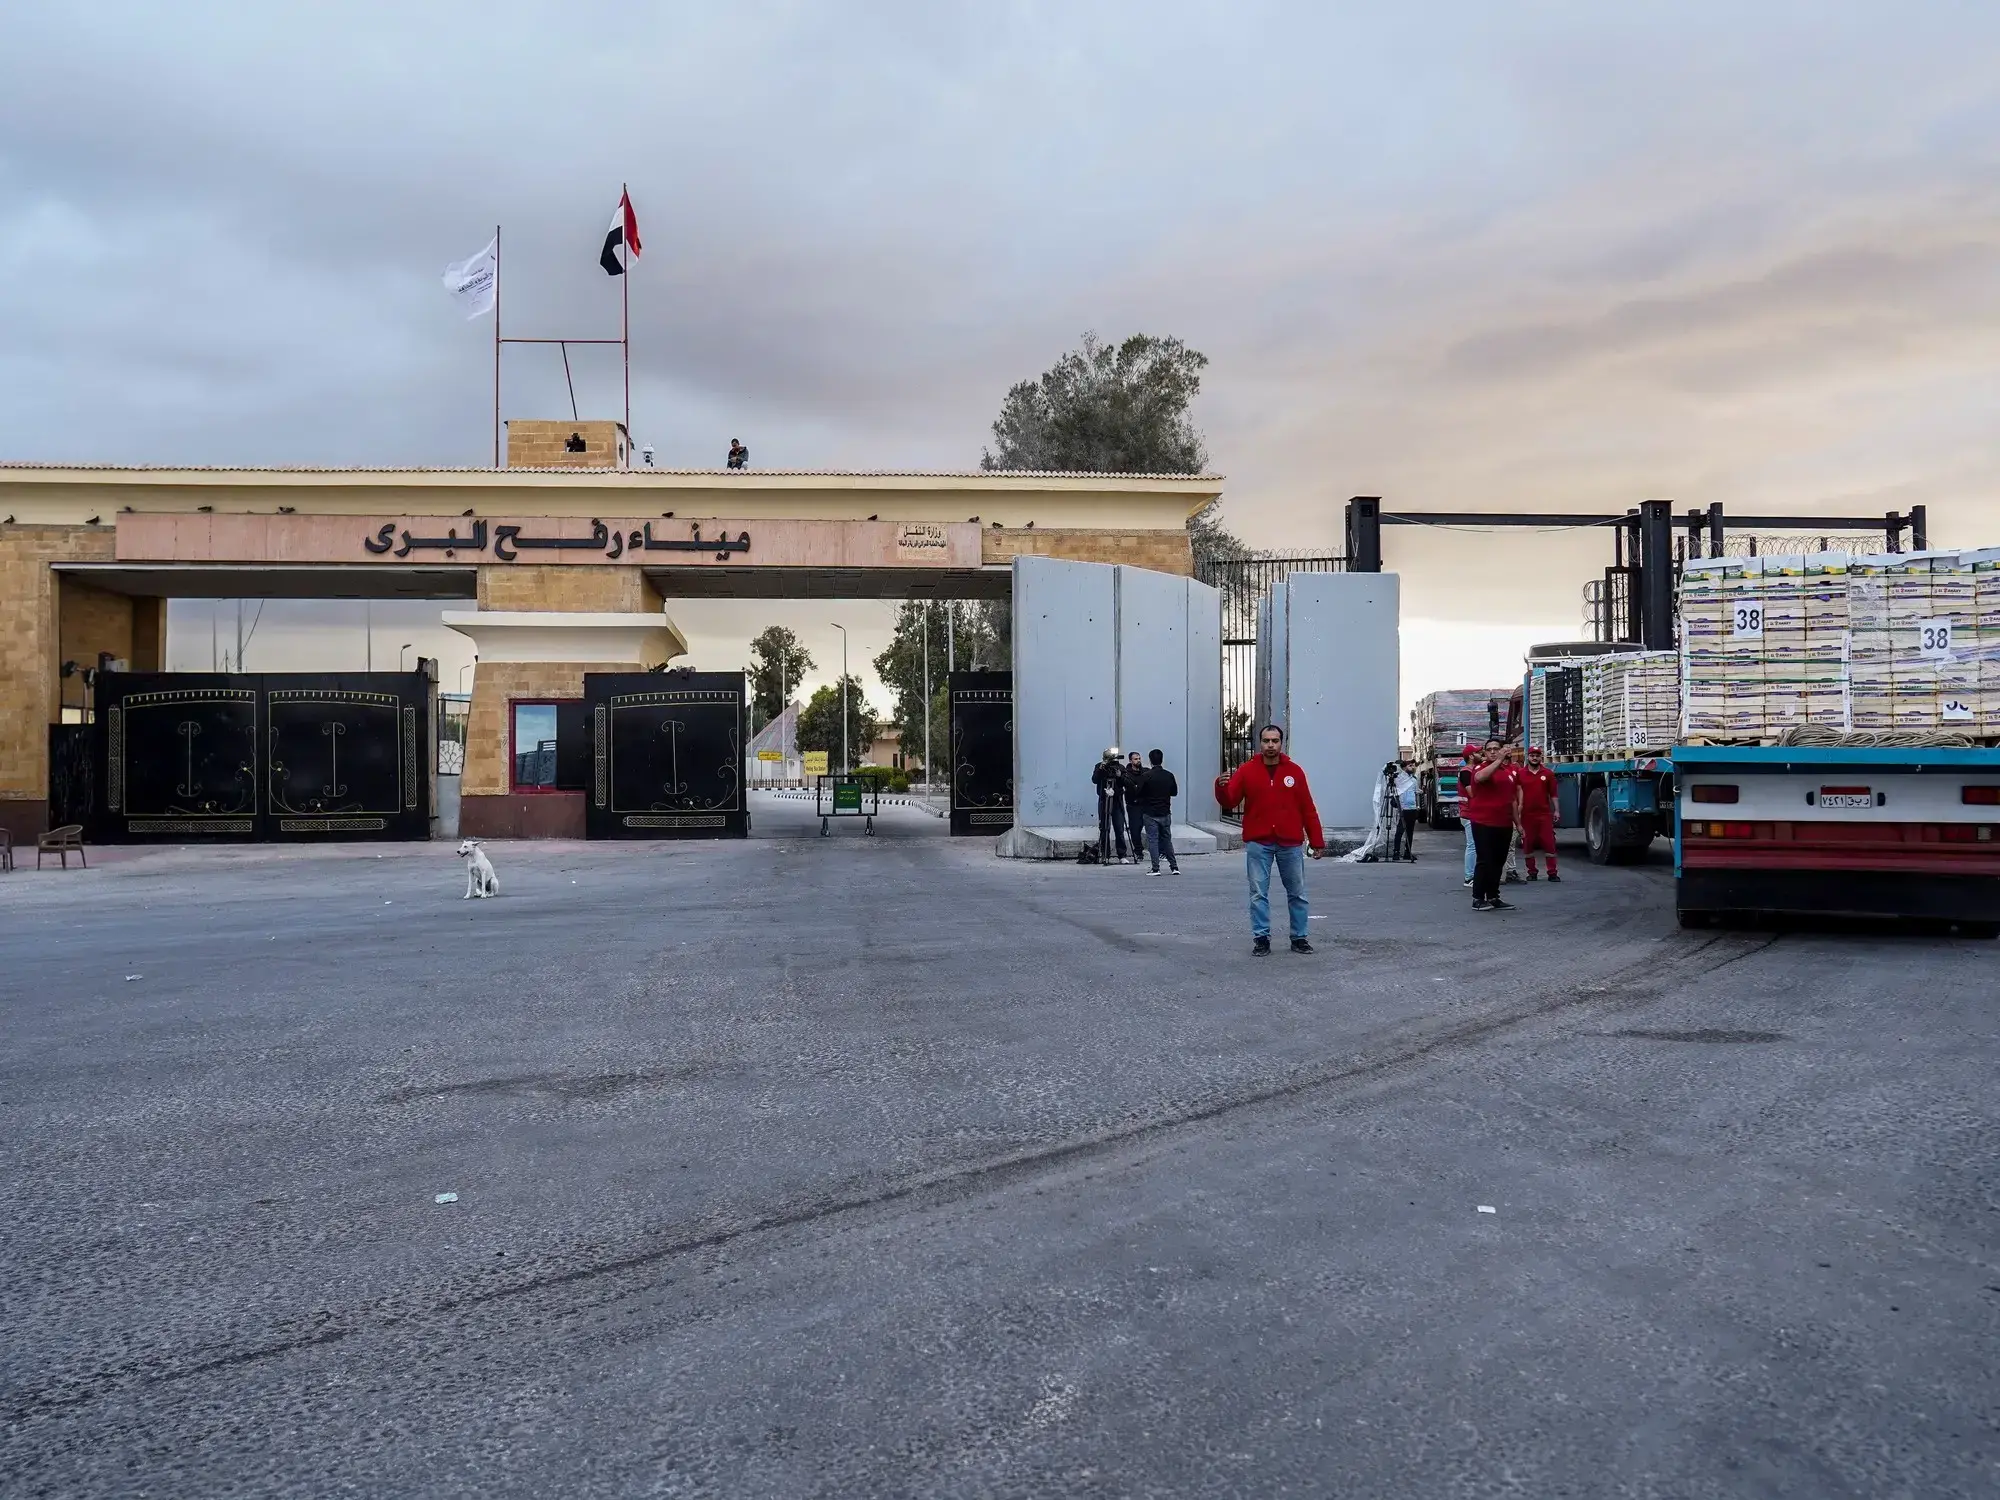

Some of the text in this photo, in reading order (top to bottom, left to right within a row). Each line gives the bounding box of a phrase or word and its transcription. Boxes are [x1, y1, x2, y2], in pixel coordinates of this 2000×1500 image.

[494, 518, 623, 560] رفح
[628, 521, 752, 560] ميناء
[1736, 608, 1760, 630] 38
[1924, 628, 1948, 650] 38
[1460, 733, 1463, 744] 1
[1634, 732, 1646, 744] 38
